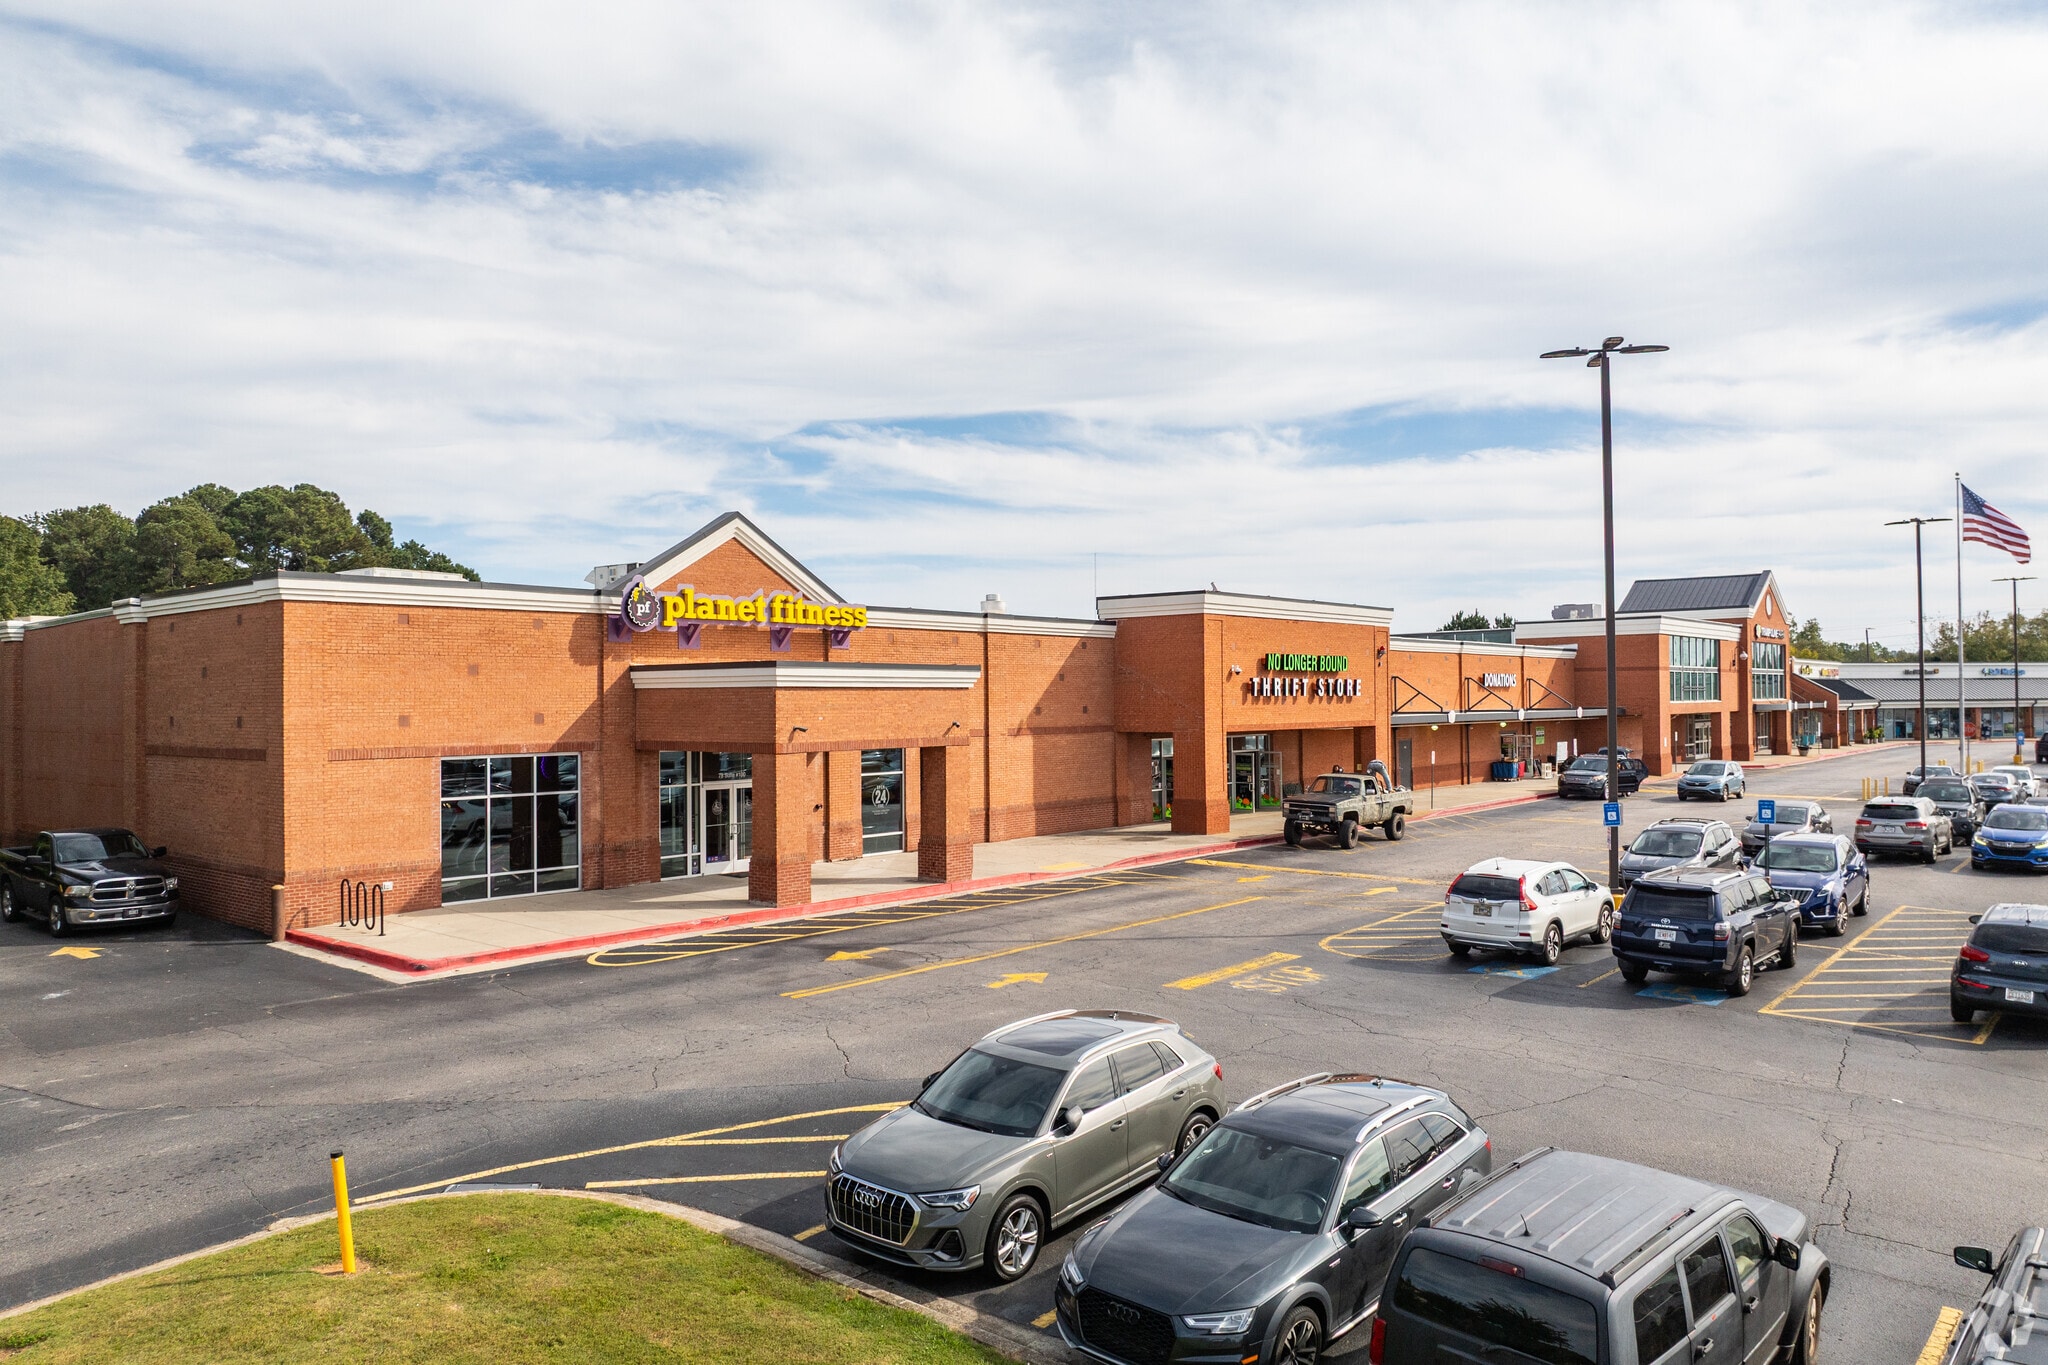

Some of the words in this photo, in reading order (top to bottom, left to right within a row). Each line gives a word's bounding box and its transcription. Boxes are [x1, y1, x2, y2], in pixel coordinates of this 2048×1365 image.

[636, 601, 651, 615] pf
[662, 588, 766, 627] planet
[770, 593, 867, 627] fitness
[1266, 653, 1281, 671] NO
[1283, 654, 1318, 671] LONGER
[1320, 655, 1348, 672] BOUND
[1252, 677, 1308, 697] THRIFT
[1317, 677, 1362, 697] STORE
[1483, 673, 1517, 688] DONATIONS
[875, 789, 887, 804] 24
